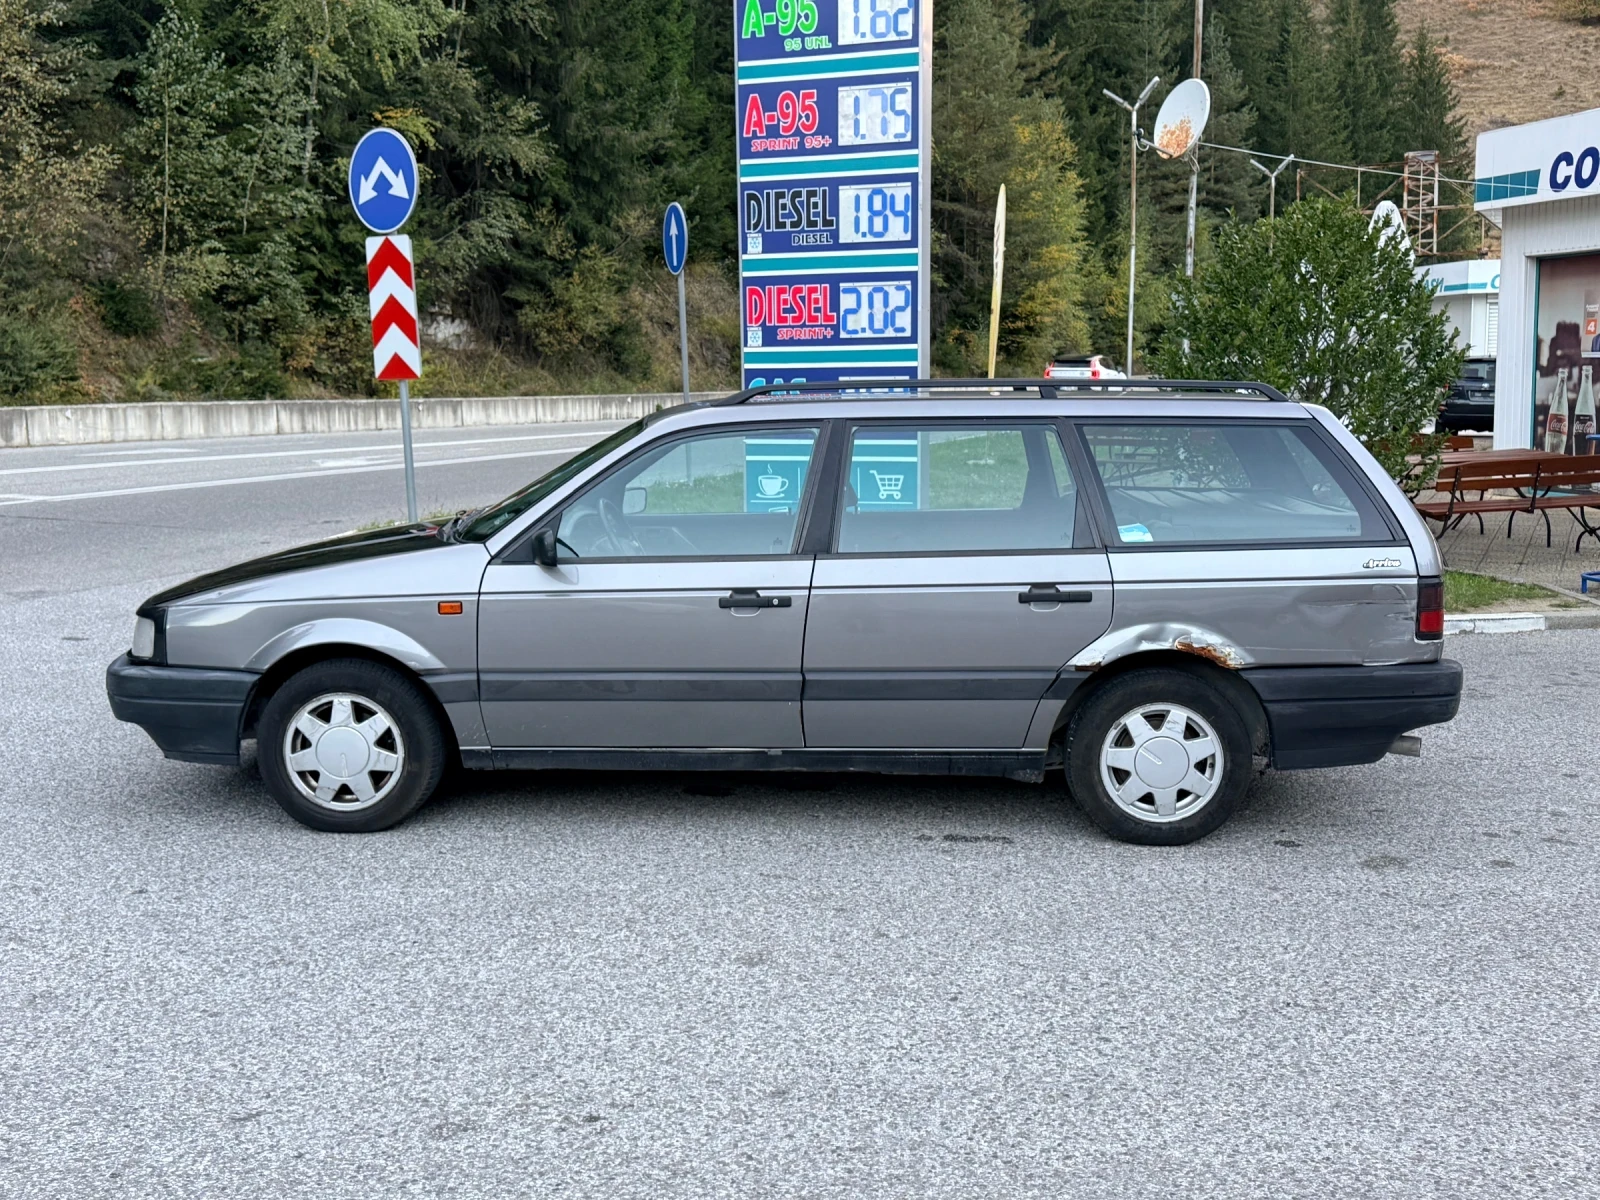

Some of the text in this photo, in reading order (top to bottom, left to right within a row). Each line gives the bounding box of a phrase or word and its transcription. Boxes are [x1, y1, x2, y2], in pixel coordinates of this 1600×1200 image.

[742, 0, 818, 38] A-95
[784, 36, 832, 51] 95 UNL
[743, 90, 819, 137] A-95
[853, 88, 910, 140] 1.75
[751, 135, 832, 152] SPRINT 95+
[744, 187, 836, 233] DIESEL
[854, 188, 910, 238] 1.84
[791, 232, 833, 246] DIESEL
[746, 284, 837, 326] DIESEL
[841, 285, 910, 334] 2.02
[777, 327, 834, 340] SPRINT+
